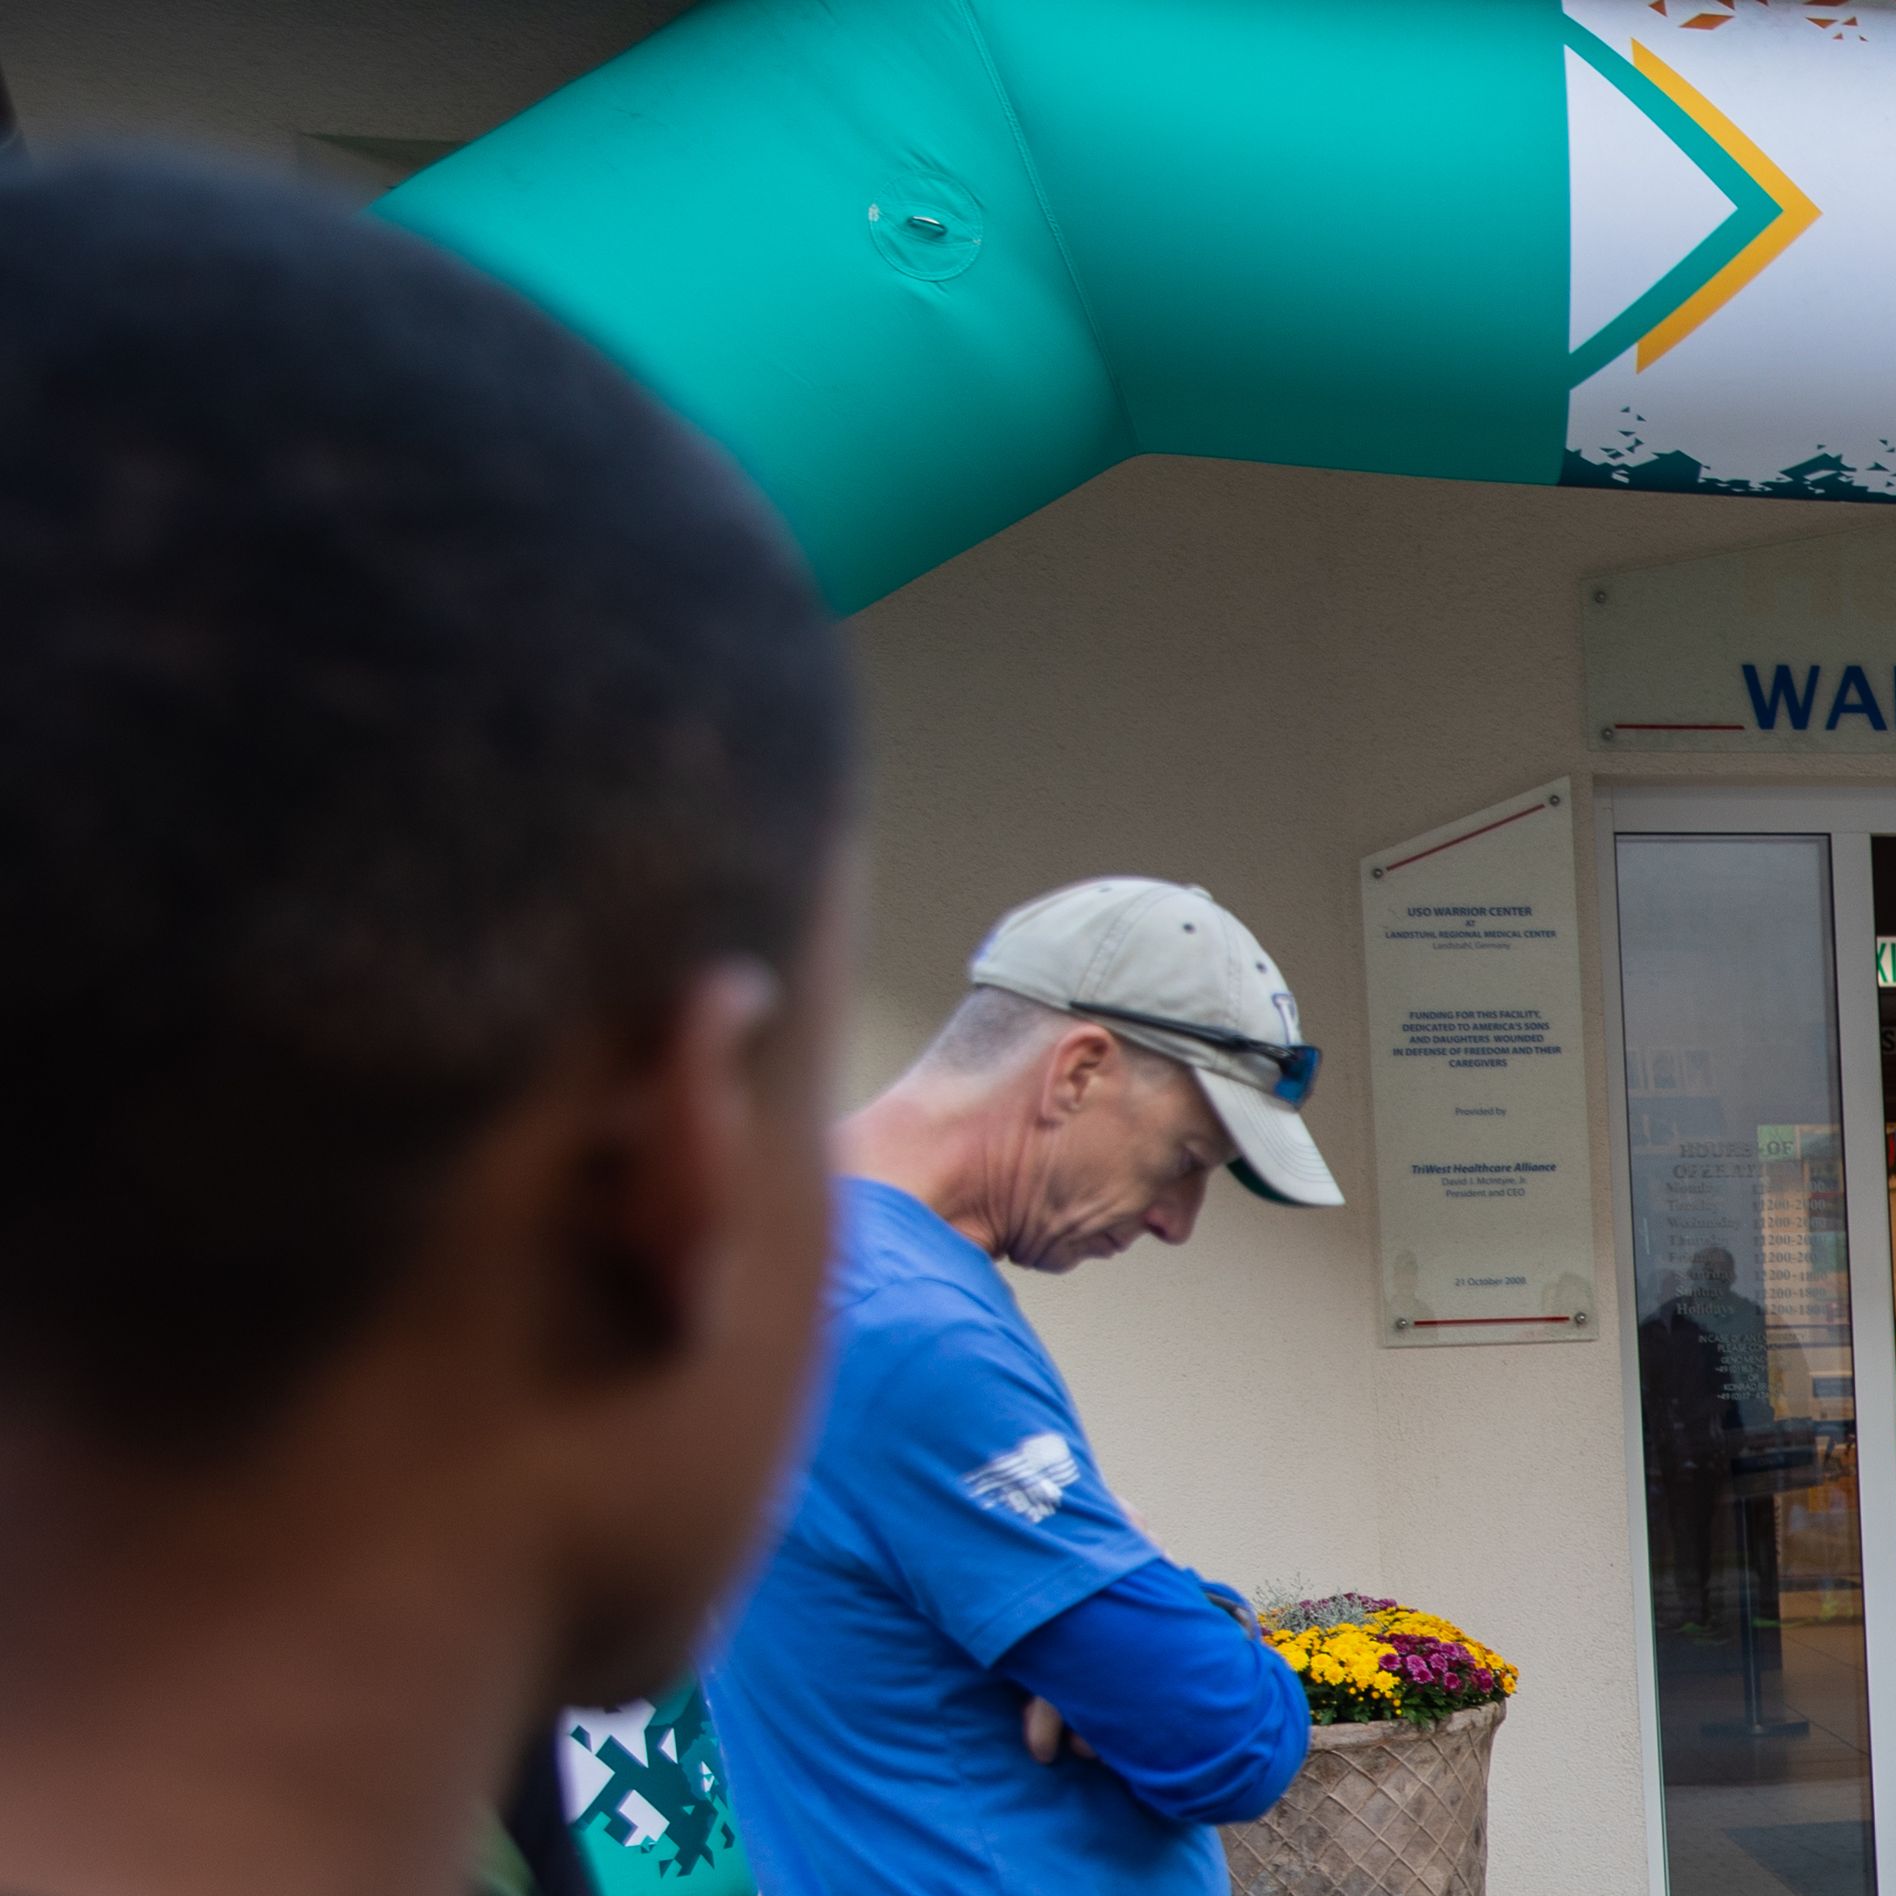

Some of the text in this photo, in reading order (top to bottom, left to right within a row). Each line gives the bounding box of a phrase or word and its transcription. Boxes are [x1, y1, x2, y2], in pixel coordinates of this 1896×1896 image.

[1408, 906, 1533, 917] USO WARRIOR CENTER
[1385, 930, 1557, 939] LANDSTUHL REGIONAL MEDICAL CENTER
[1409, 1011, 1454, 1019] FUNDING
[1455, 1011, 1475, 1019] FOR
[1476, 1011, 1497, 1019] THIS
[1402, 1022, 1550, 1032] DEDICATED TO AMERICA'S SONS
[1409, 1034, 1544, 1044] AND DAUGHTERS WOUNDED
[1393, 1046, 1562, 1056] IN DEFENSE OF FREEDOM AND THEIR
[1448, 1059, 1508, 1068] CAREGIVERS
[1454, 1106, 1507, 1117] Provided by
[1766, 1140, 1795, 1156] OF
[1411, 1162, 1557, 1174] TriWest Healthcare Alliance
[1441, 1177, 1466, 1186] David
[1445, 1188, 1526, 1198] President and CEO
[1467, 1277, 1503, 1287] October
[1676, 1302, 1736, 1318] Holidays
